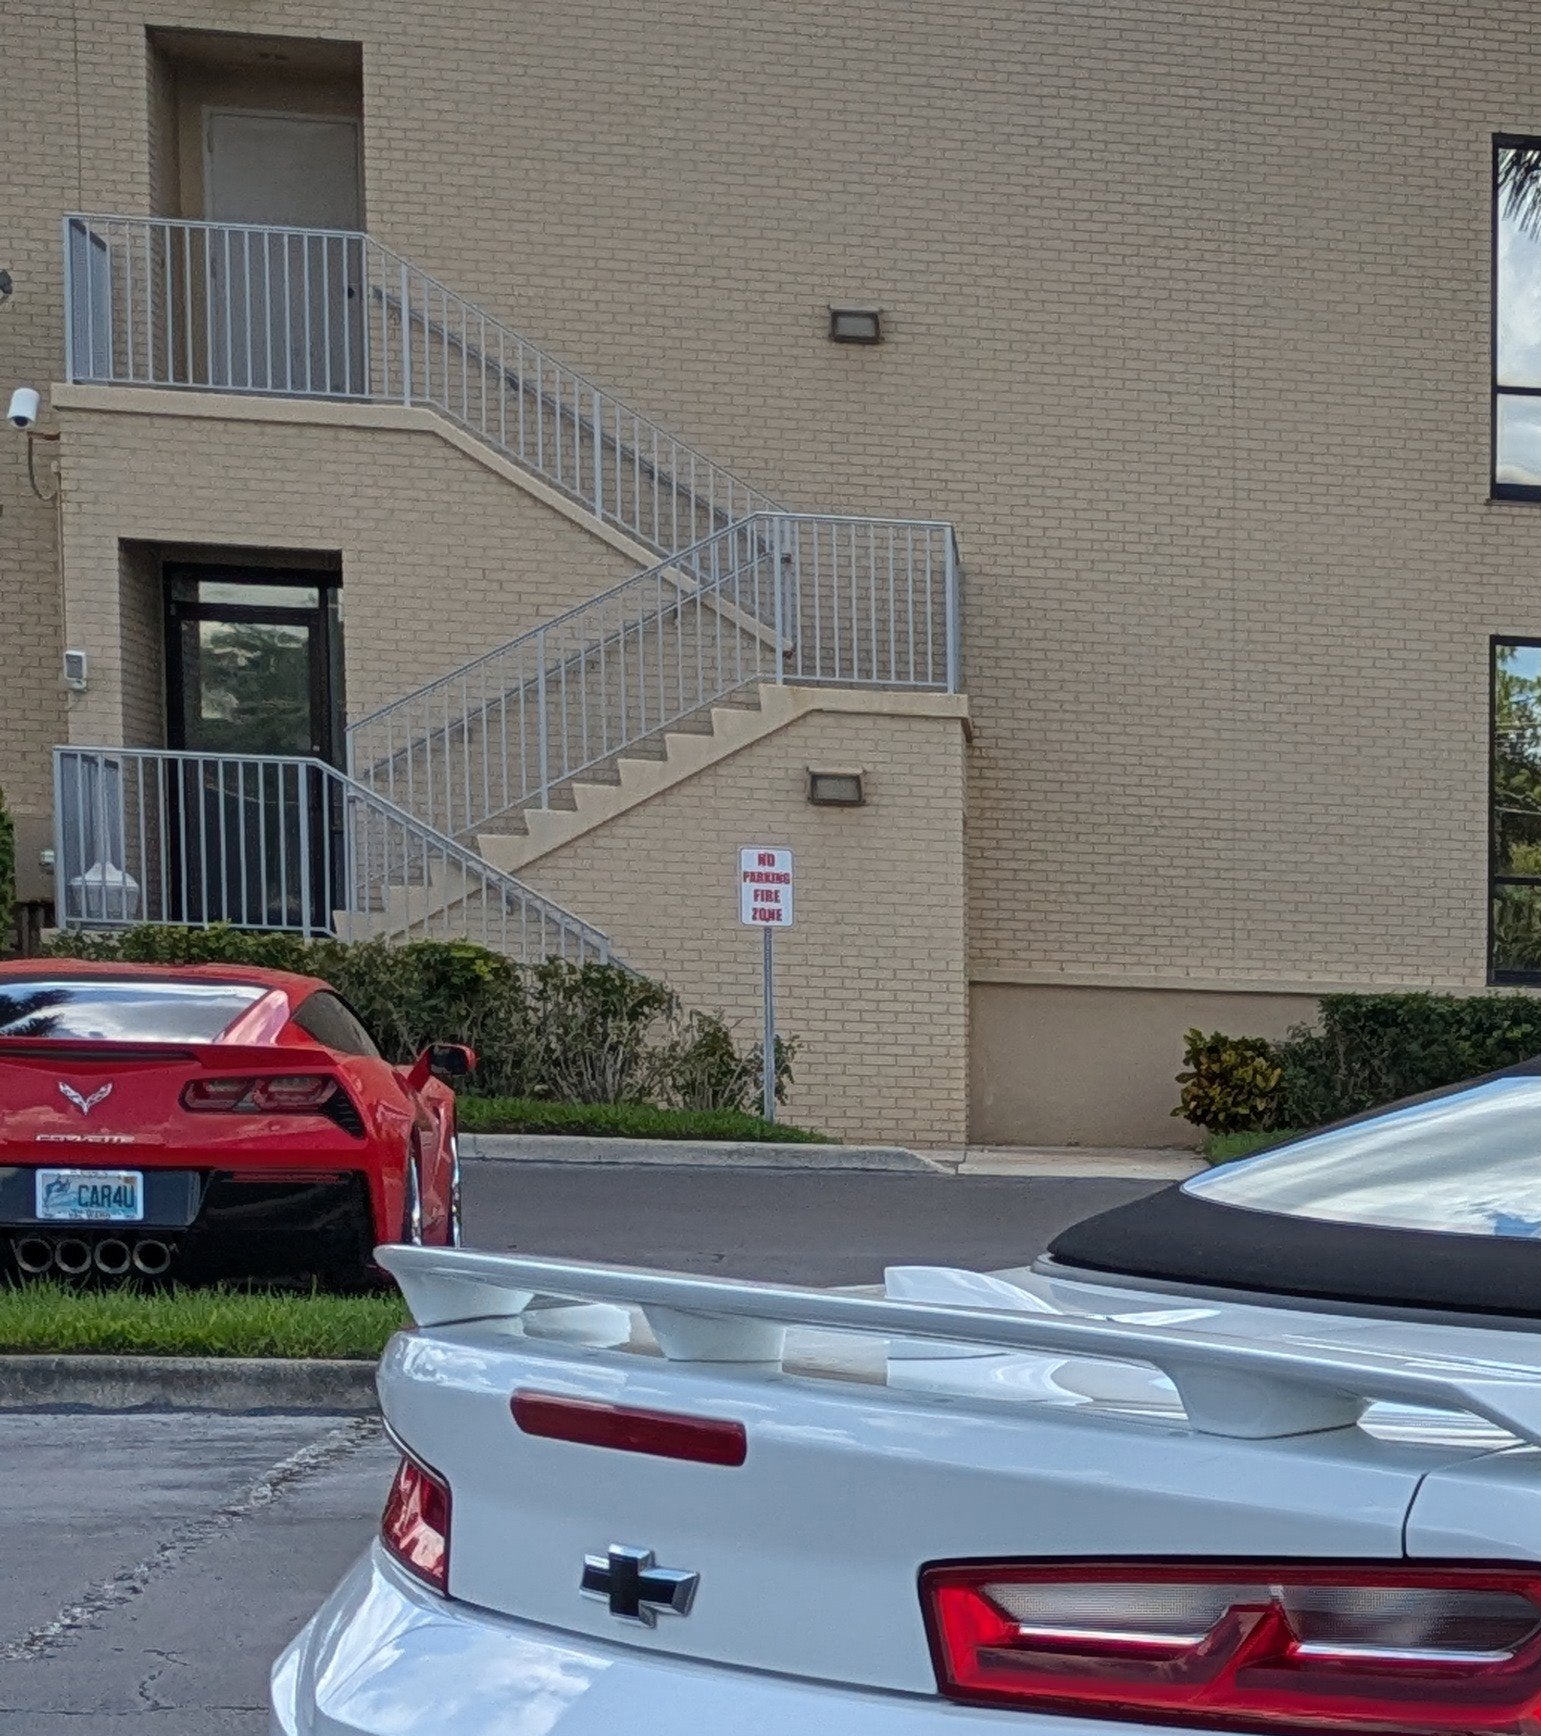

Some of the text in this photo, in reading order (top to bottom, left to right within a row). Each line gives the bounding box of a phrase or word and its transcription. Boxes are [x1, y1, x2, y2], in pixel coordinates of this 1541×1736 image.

[757, 852, 776, 867] NO
[743, 871, 790, 885] PARKING
[753, 889, 781, 903] FIRE
[751, 907, 783, 922] ZONE
[77, 1184, 135, 1208] CAR4U
